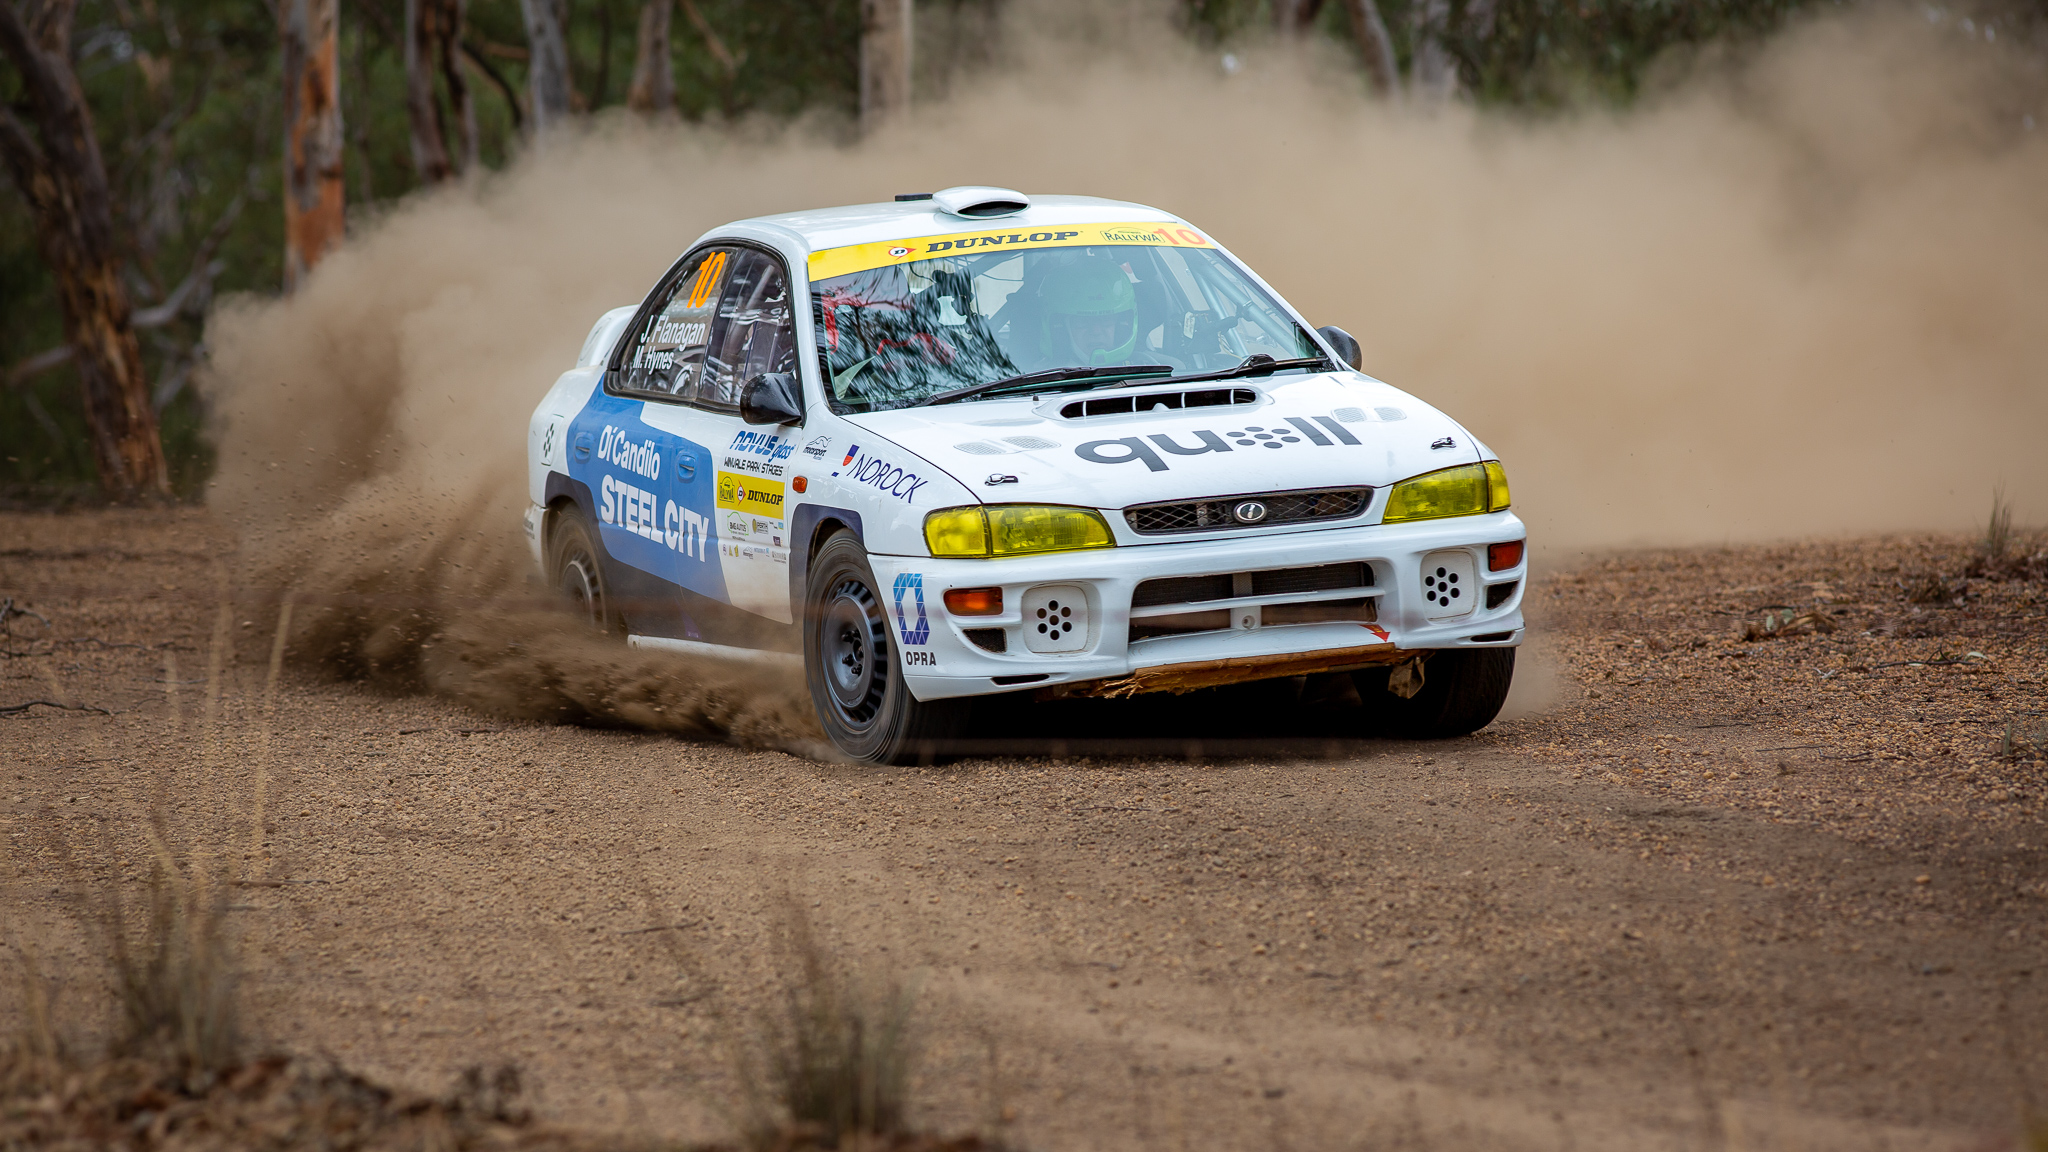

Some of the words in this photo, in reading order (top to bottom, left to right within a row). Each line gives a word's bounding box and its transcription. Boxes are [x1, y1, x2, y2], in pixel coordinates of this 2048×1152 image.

[926, 231, 1078, 253] DUNLOP
[1104, 232, 1161, 242] RALLYWA
[1153, 228, 1206, 245] 10
[687, 251, 726, 308] 10
[640, 314, 654, 343] J.
[651, 315, 706, 352] Flanagan
[632, 345, 645, 368] M.
[644, 345, 675, 375] Hynes
[612, 430, 661, 481] Candilo
[729, 430, 779, 456] NOVUS
[767, 438, 796, 463] glass
[746, 460, 762, 473] PARK
[761, 463, 784, 477] STAGES
[846, 453, 929, 504] NOROCK
[747, 489, 784, 506] DUNLOP
[600, 474, 664, 545] STEEL
[664, 498, 710, 563] CITY
[905, 651, 937, 666] OPRA
